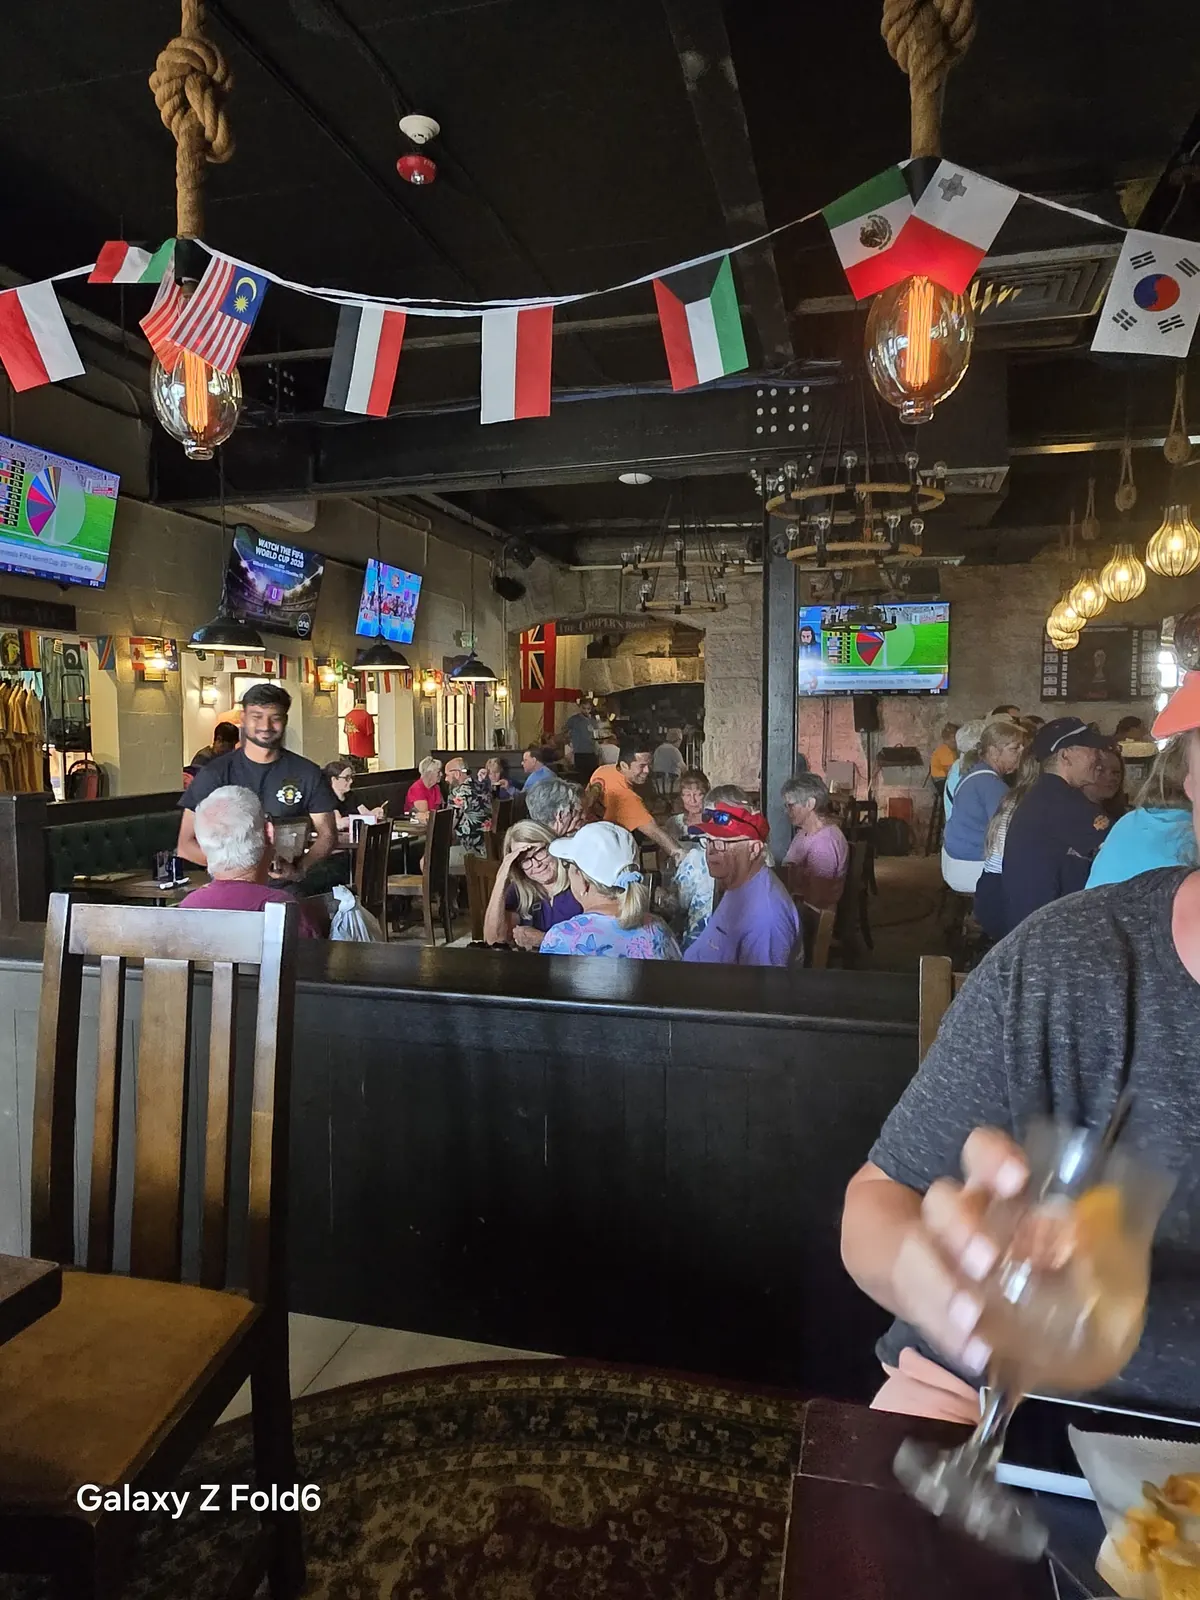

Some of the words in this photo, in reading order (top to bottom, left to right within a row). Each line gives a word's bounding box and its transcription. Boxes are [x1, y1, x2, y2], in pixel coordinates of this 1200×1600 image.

[255, 546, 278, 560] WORLD
[278, 554, 290, 564] CUP
[258, 538, 280, 552] WATCH
[280, 545, 292, 557] THE
[292, 549, 304, 560] FIFA
